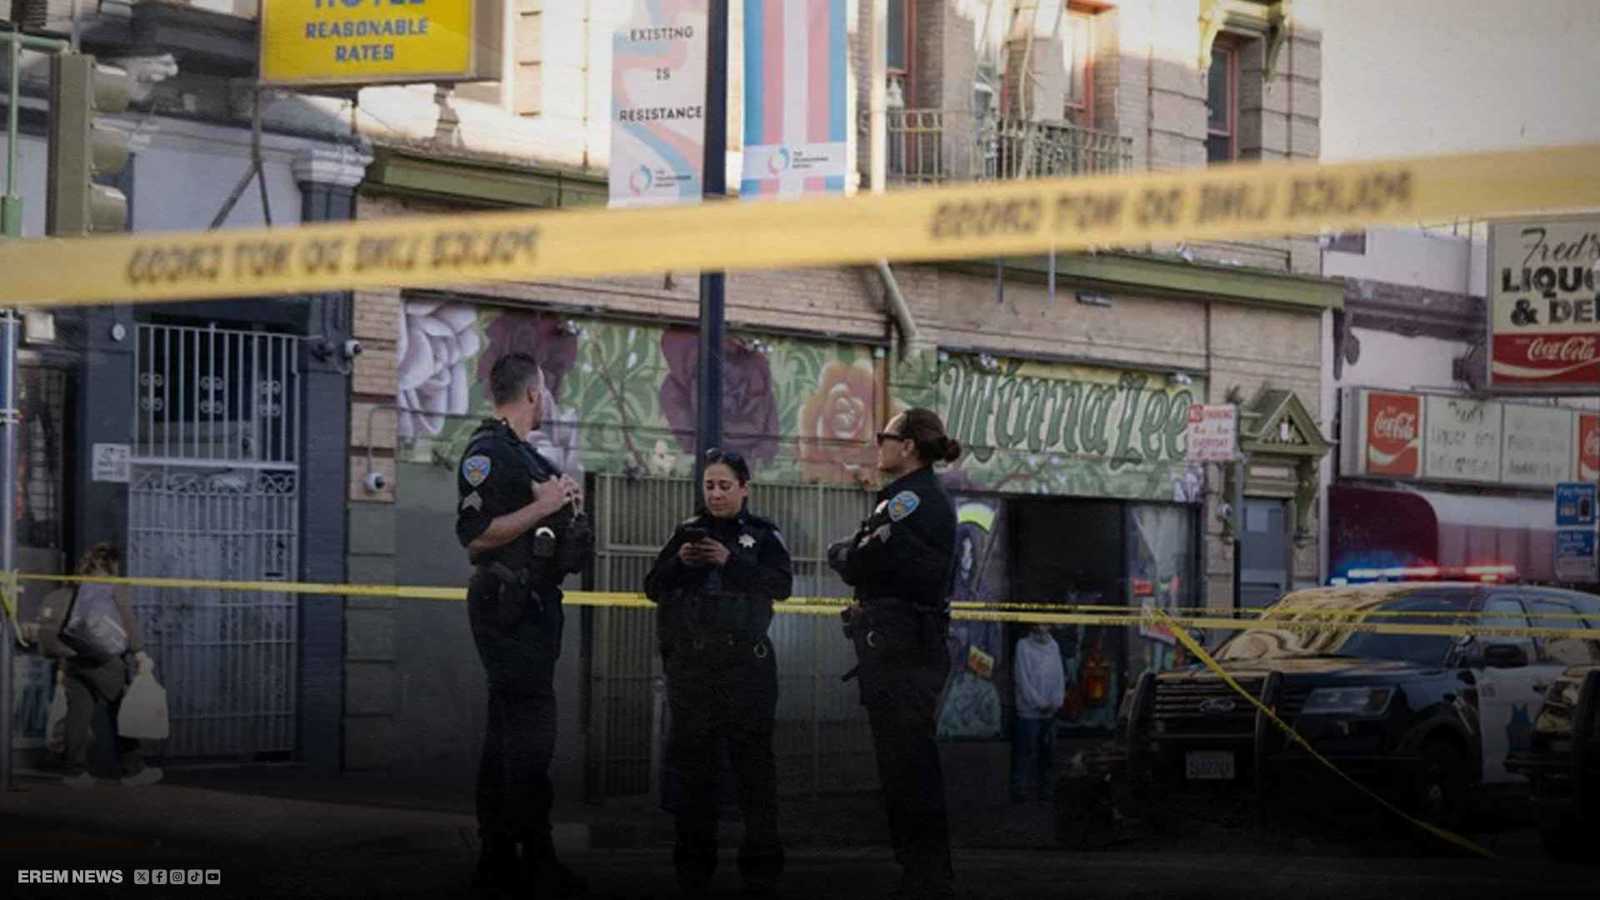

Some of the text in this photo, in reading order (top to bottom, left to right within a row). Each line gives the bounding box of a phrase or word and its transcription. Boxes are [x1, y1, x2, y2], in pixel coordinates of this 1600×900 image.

[305, 18, 428, 38] REASONABLE
[630, 26, 694, 41] EXISTING
[335, 43, 395, 63] RATES
[656, 67, 671, 80] IS
[620, 105, 703, 121] RESISTANCE
[1510, 299, 1538, 325] &
